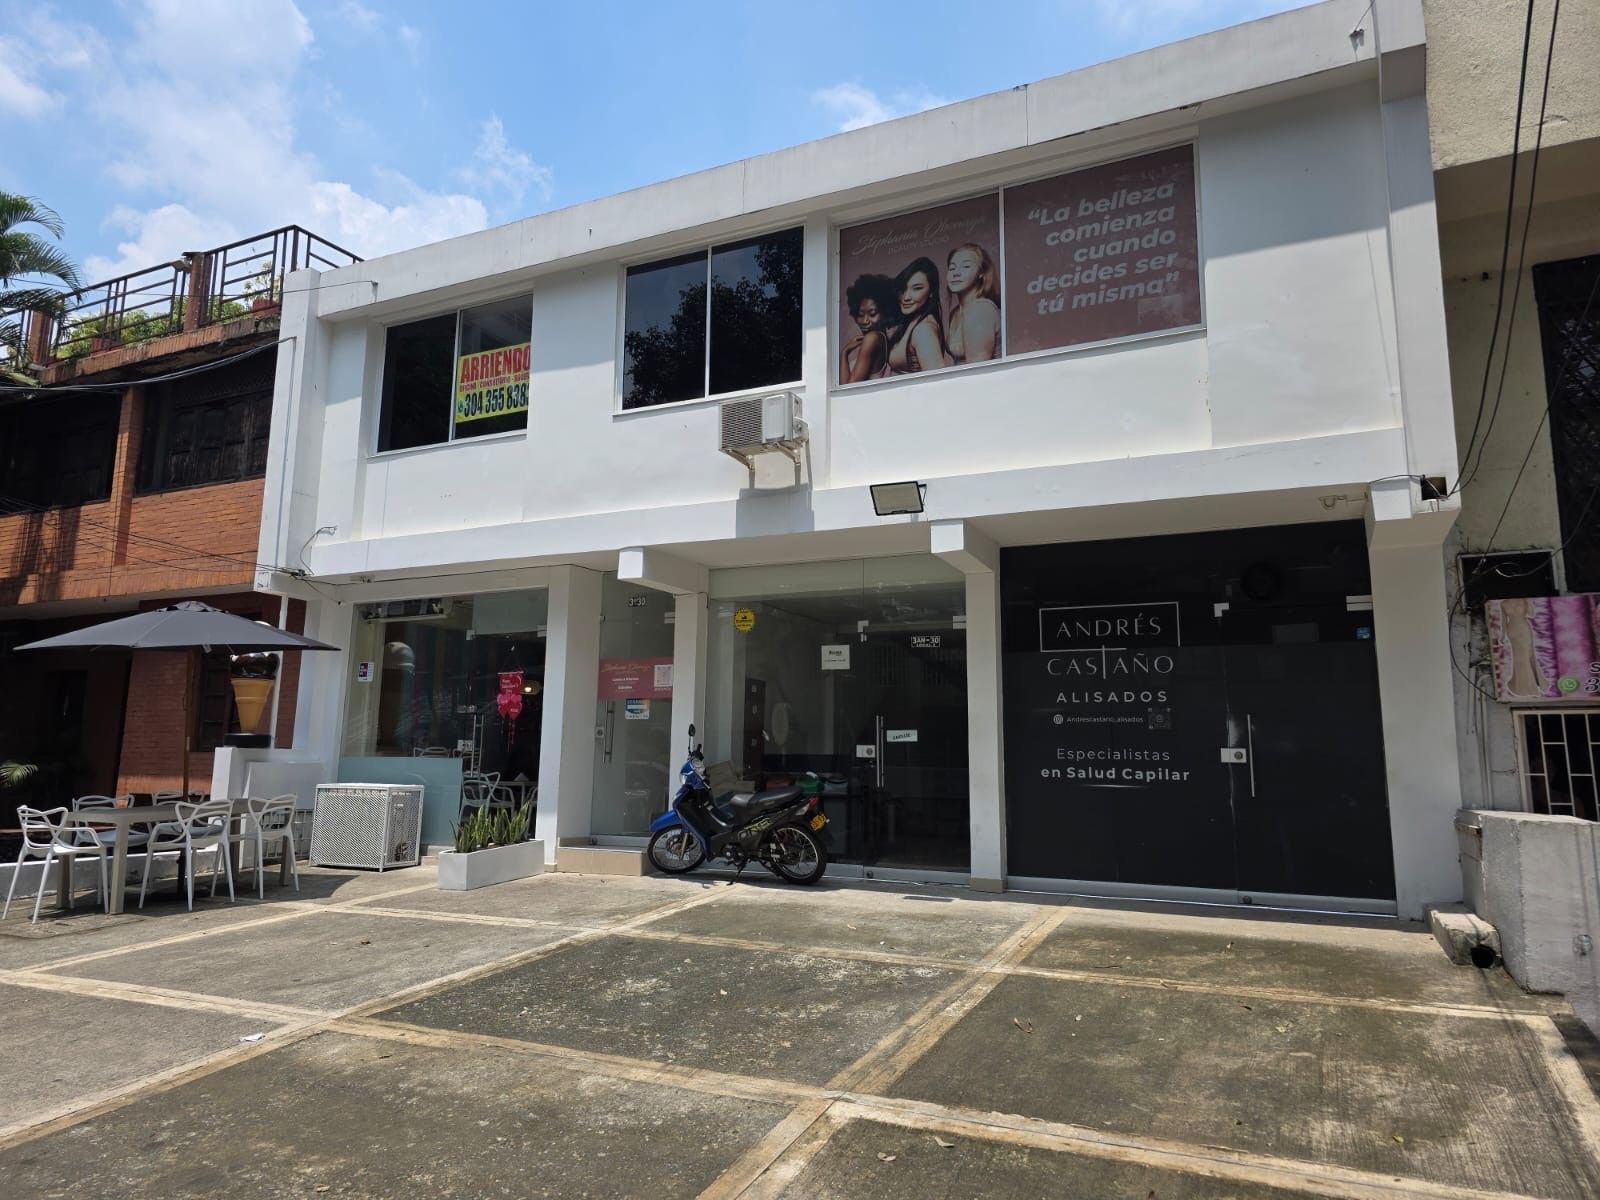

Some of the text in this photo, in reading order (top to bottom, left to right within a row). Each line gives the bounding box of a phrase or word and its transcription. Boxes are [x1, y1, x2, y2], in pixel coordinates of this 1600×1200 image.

[1077, 183, 1176, 217] belleza
[1046, 206, 1175, 246] comienza
[1074, 228, 1177, 262] cuando
[1026, 252, 1179, 295] decides ser
[1038, 291, 1064, 315] tú
[461, 345, 530, 383] ARRIENDO
[464, 383, 530, 417] 304 355 838
[1056, 612, 1161, 639] ANDRÉS
[1047, 645, 1174, 679] CASTAÑO
[1056, 690, 1168, 703] ALISADOS
[1056, 748, 1170, 761] Especialistas
[1041, 766, 1190, 782] en Salud Capilar
